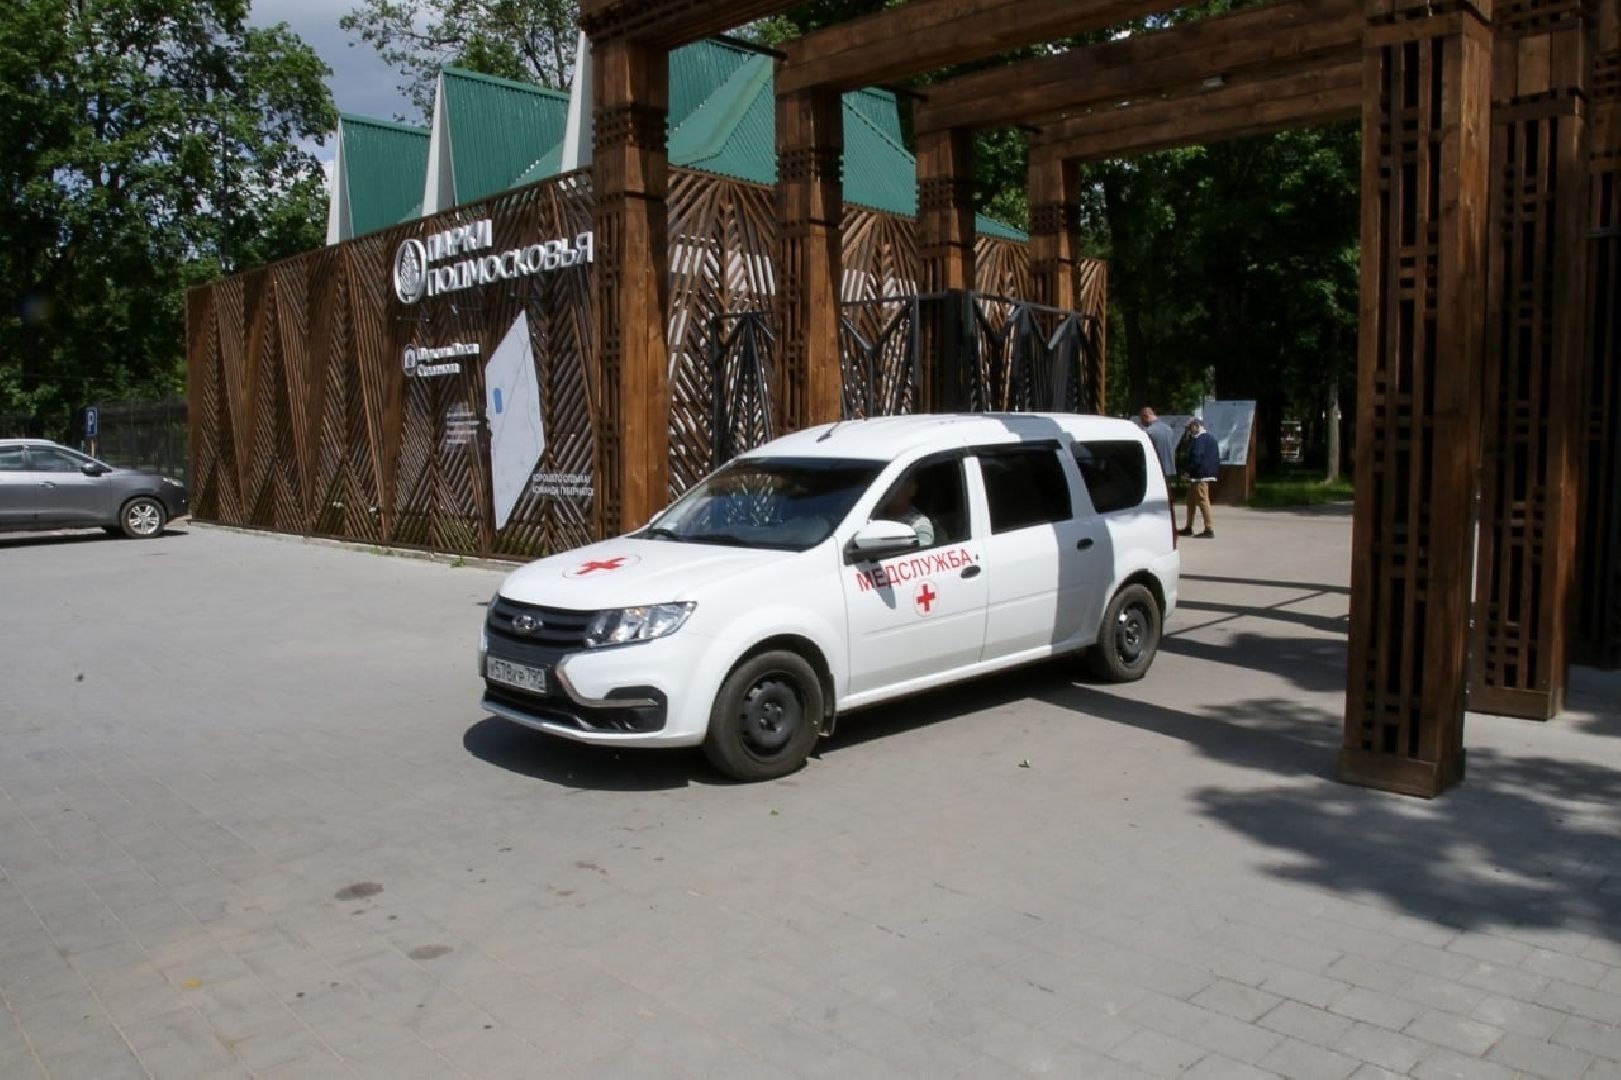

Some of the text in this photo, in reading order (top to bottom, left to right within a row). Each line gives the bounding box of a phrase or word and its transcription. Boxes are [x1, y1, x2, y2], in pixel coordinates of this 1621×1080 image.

[427, 219, 493, 263] ПАРКИ
[427, 231, 593, 297] ПОДМОСКОВЬЯ
[856, 548, 972, 592] МЕДСЛУЖБА
